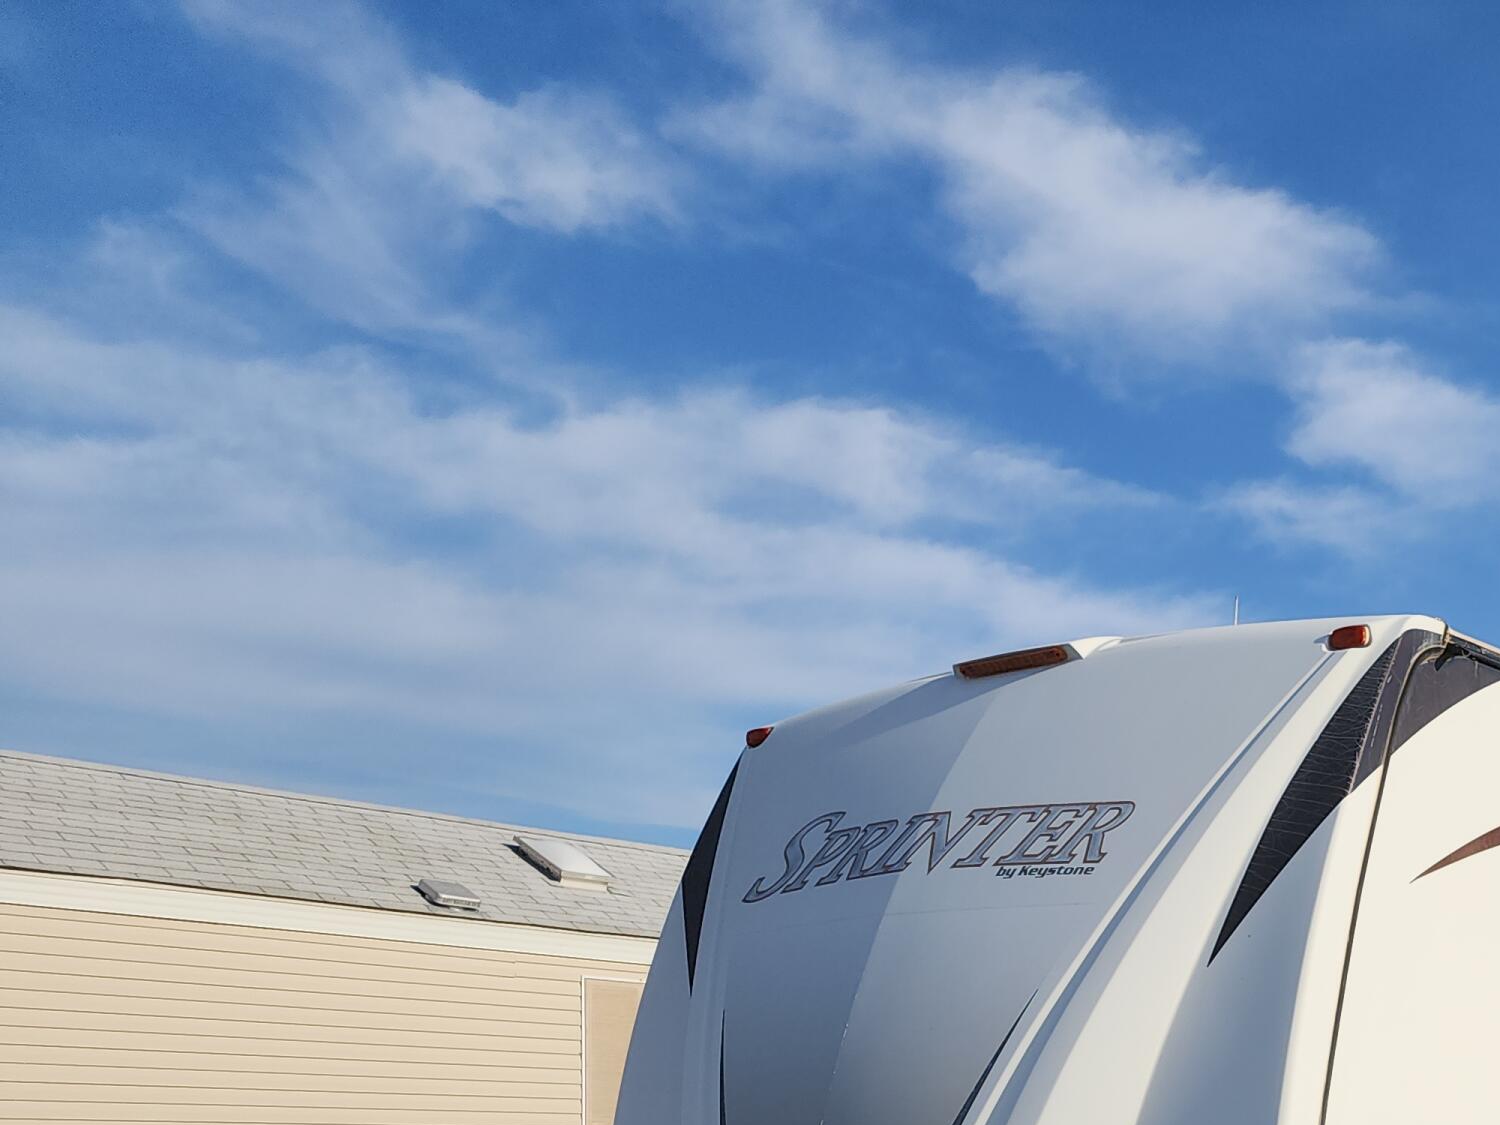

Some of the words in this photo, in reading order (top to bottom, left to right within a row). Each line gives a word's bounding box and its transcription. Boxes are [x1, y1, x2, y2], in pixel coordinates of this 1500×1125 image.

[742, 801, 1136, 903] SPRINTER
[995, 866, 1017, 879] by
[1018, 866, 1095, 878] Keystone
